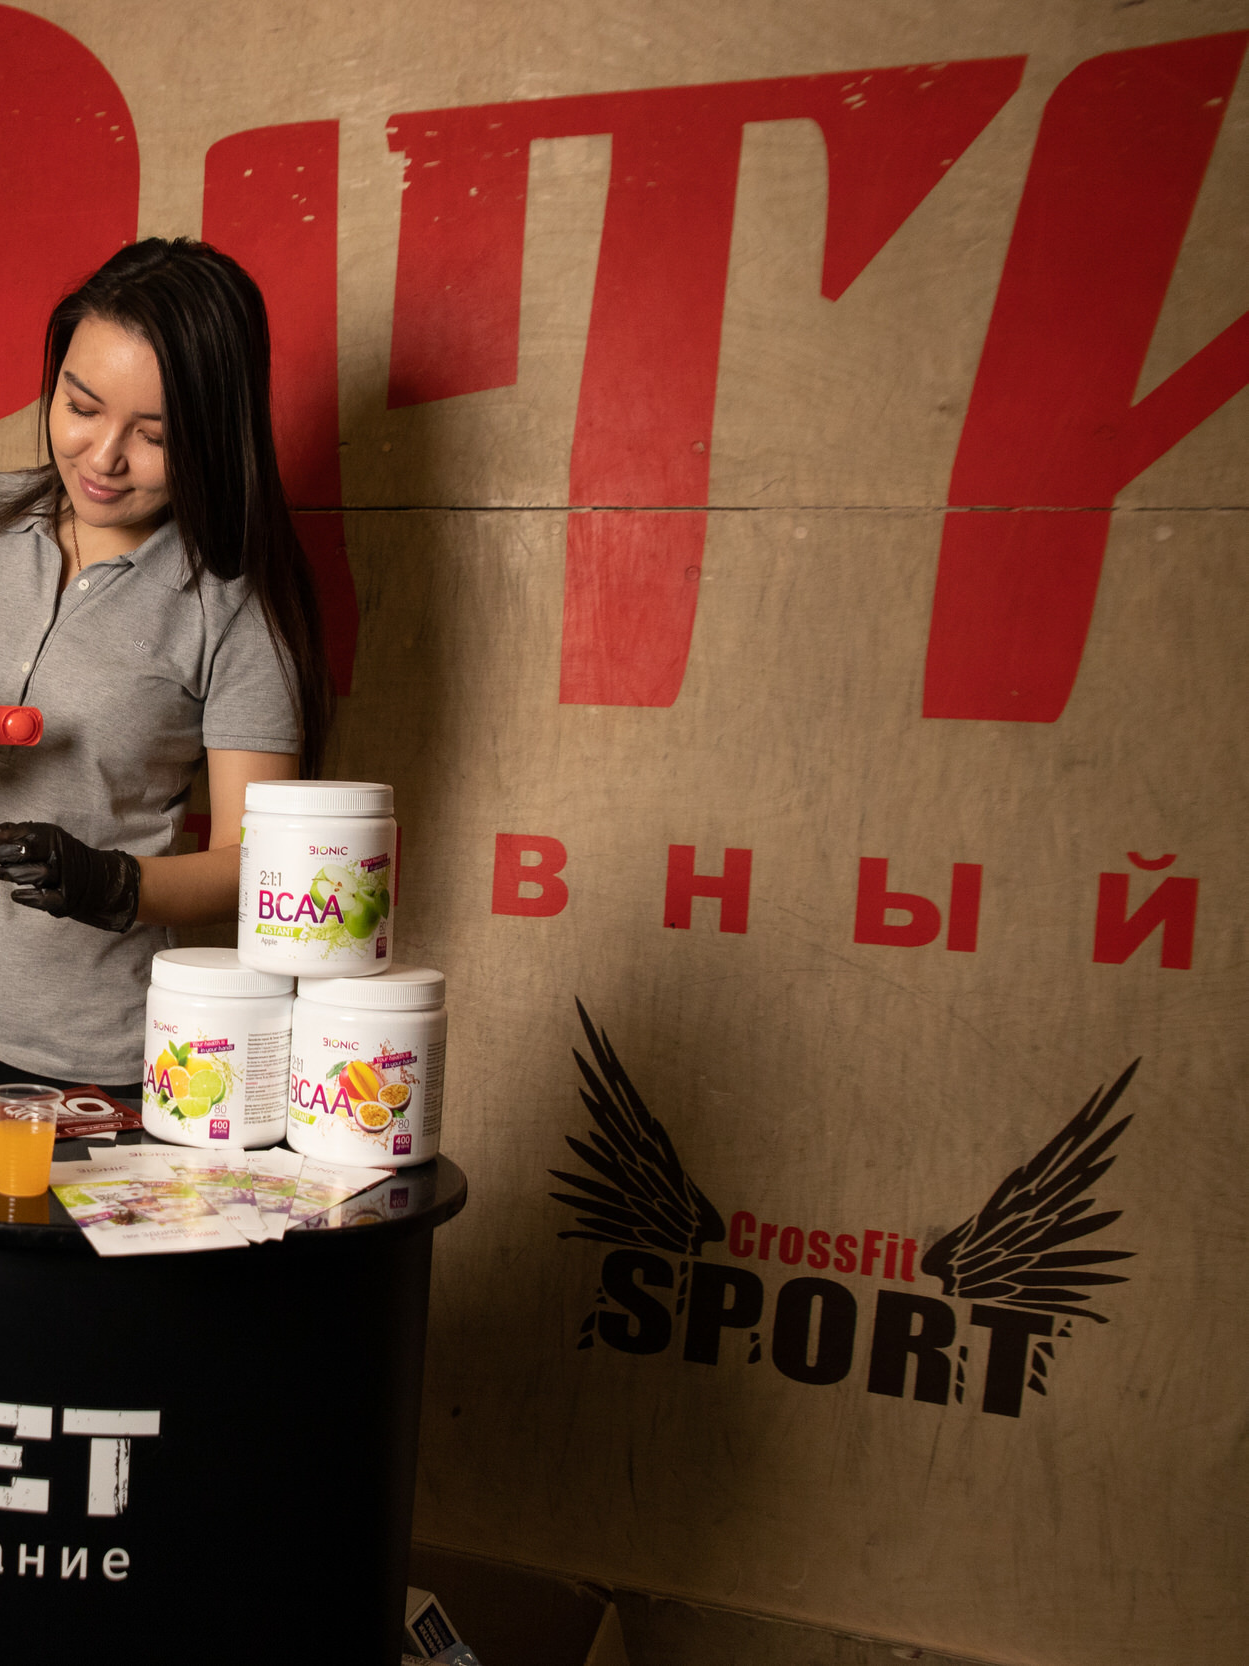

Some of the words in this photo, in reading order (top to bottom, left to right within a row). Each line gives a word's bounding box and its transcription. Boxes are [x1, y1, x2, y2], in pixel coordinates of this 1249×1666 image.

[309, 845, 349, 856] BIONIC
[259, 870, 282, 887] 2:1:1
[258, 889, 345, 925] BCAA
[260, 925, 295, 937] INSTANT
[260, 937, 278, 946] Apple
[153, 1019, 179, 1034] BIONIC
[323, 1037, 360, 1051] BIONIC
[290, 1074, 354, 1118] BCAA
[214, 1104, 227, 1114] 80
[211, 1121, 229, 1130] 400
[397, 1118, 410, 1129] 80
[395, 1135, 411, 1145] 400
[728, 1209, 918, 1283] CrossFit
[597, 1247, 1056, 1419] SPORT
